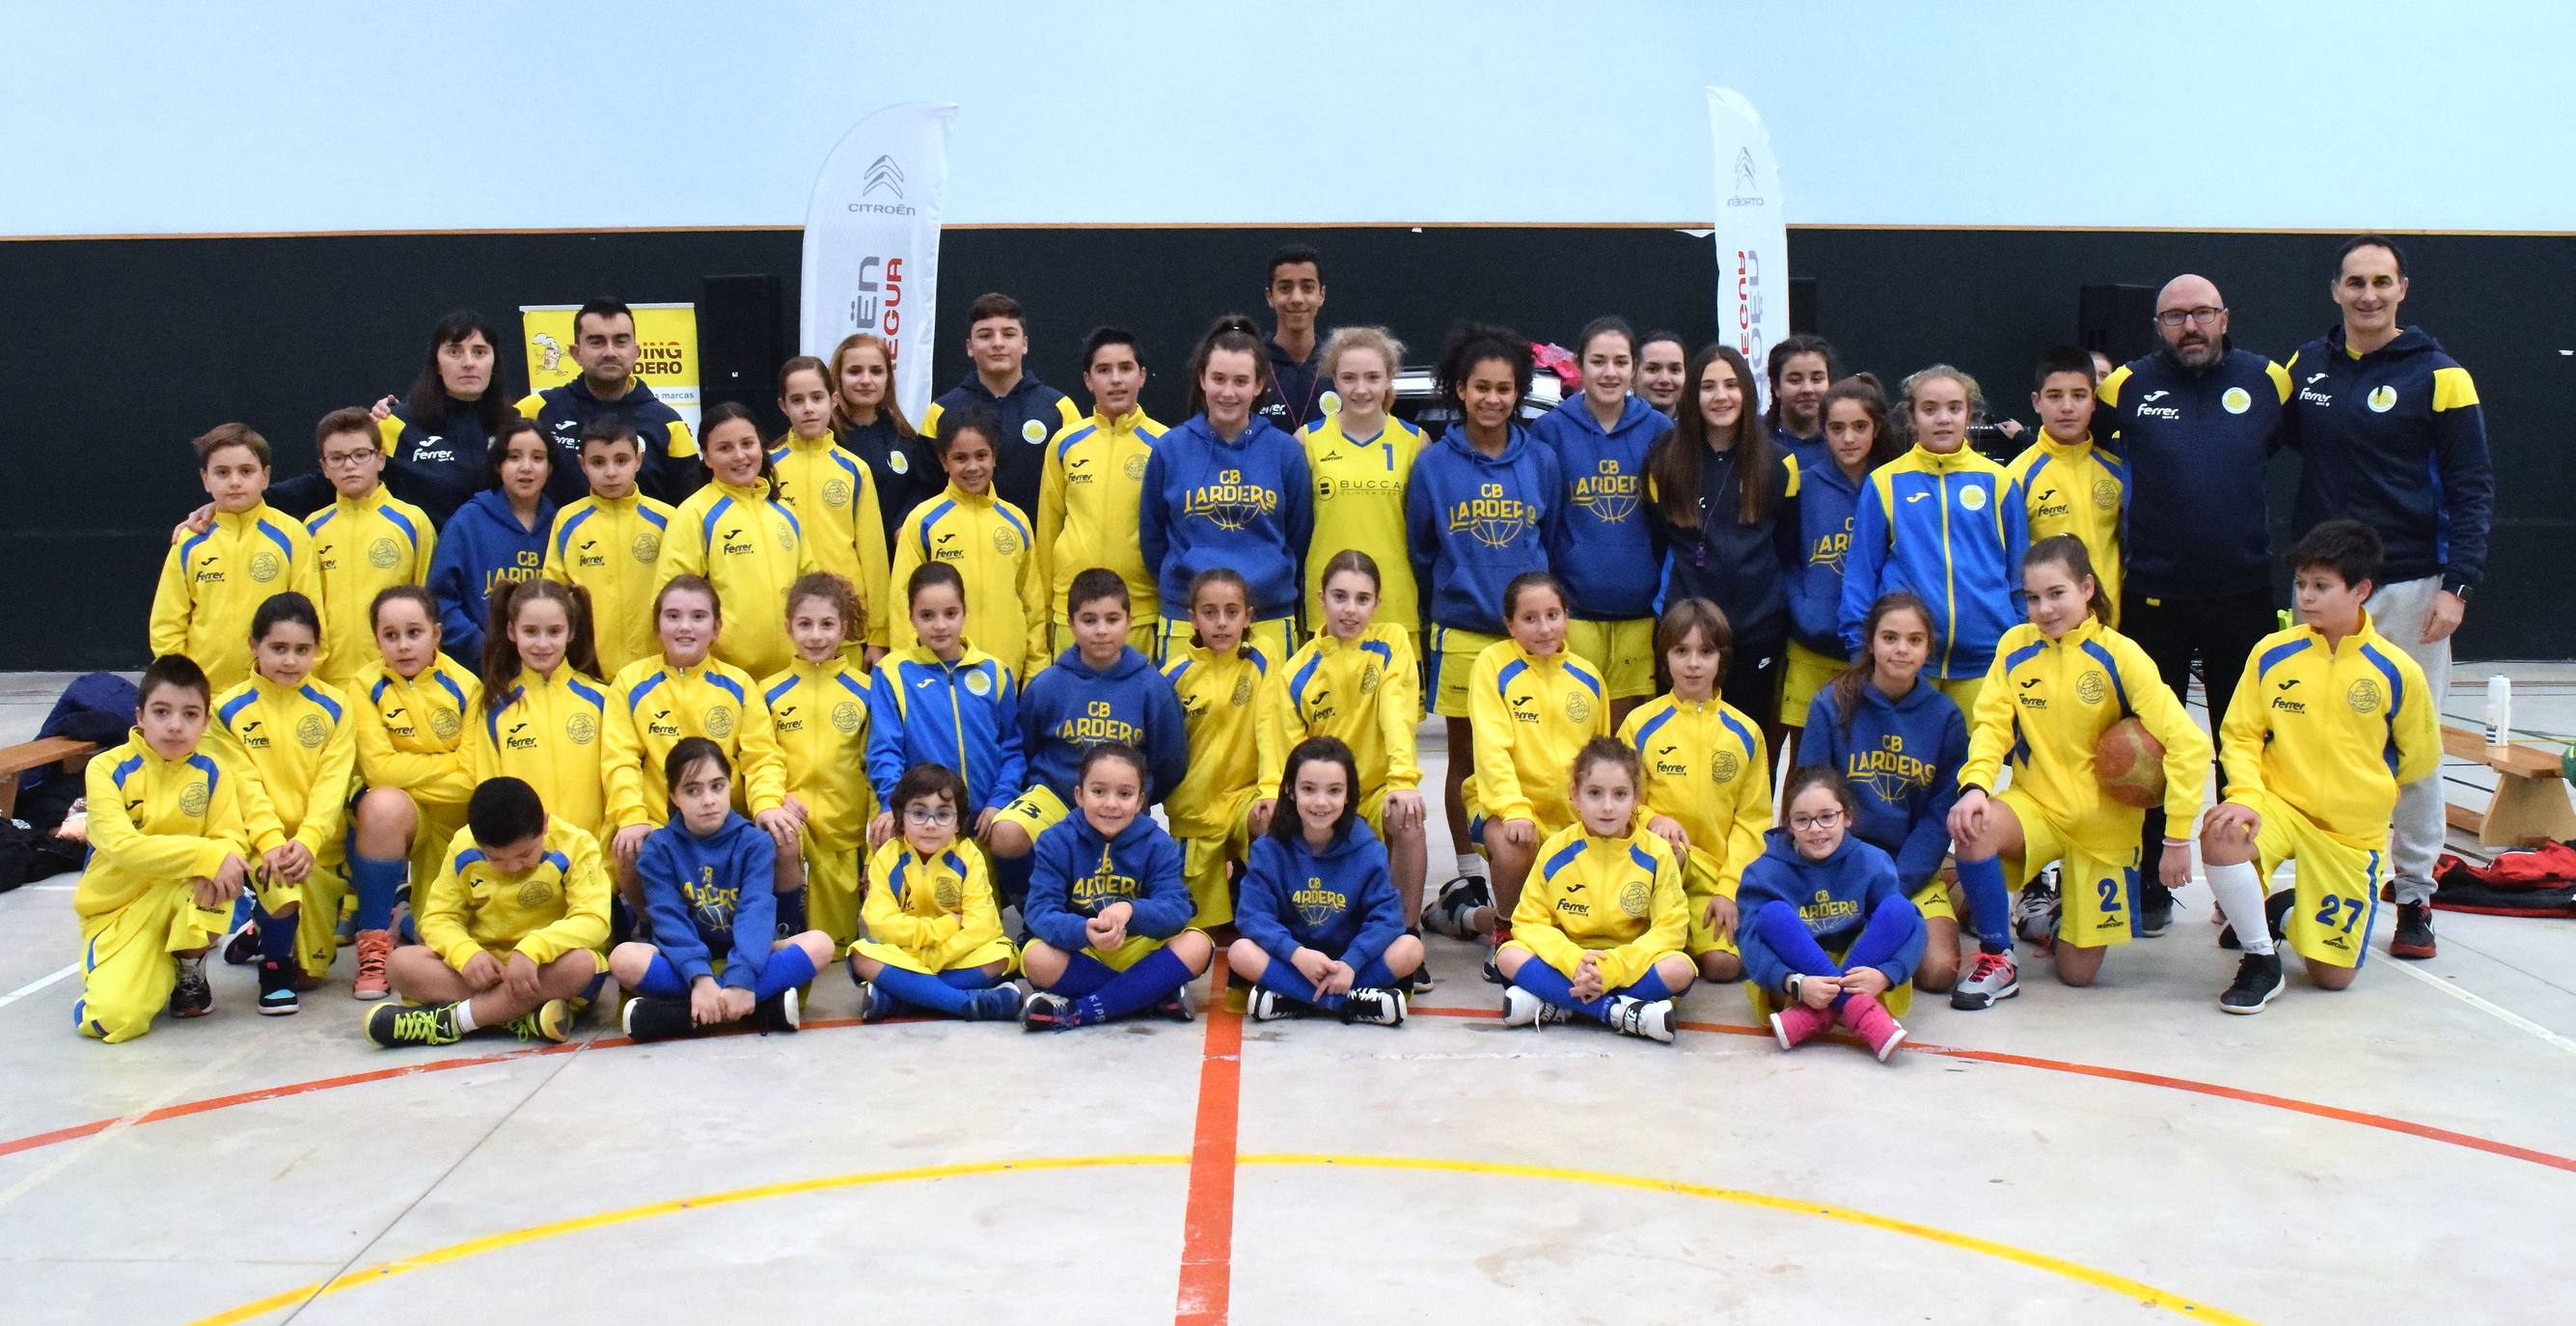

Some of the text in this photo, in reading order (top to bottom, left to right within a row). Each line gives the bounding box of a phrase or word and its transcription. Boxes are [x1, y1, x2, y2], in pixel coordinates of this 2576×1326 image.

[884, 258, 903, 370] EGUA
[637, 342, 682, 359] ING
[1382, 443, 1394, 471] 1
[1599, 459, 1619, 475] CB
[1219, 470, 1241, 484] CB
[1184, 485, 1277, 513] LARDERO
[1481, 483, 1503, 498] CB
[1810, 533, 1853, 562] LAR
[517, 551, 539, 566] CB
[1087, 701, 1110, 717] CB
[1882, 734, 1903, 752] CB
[1847, 750, 1936, 787] LARDERO
[1008, 800, 1042, 818] 13
[1308, 877, 1322, 889] CB
[1816, 890, 1830, 903] CB
[2097, 878, 2122, 912] 2
[2316, 894, 2364, 933] 27
